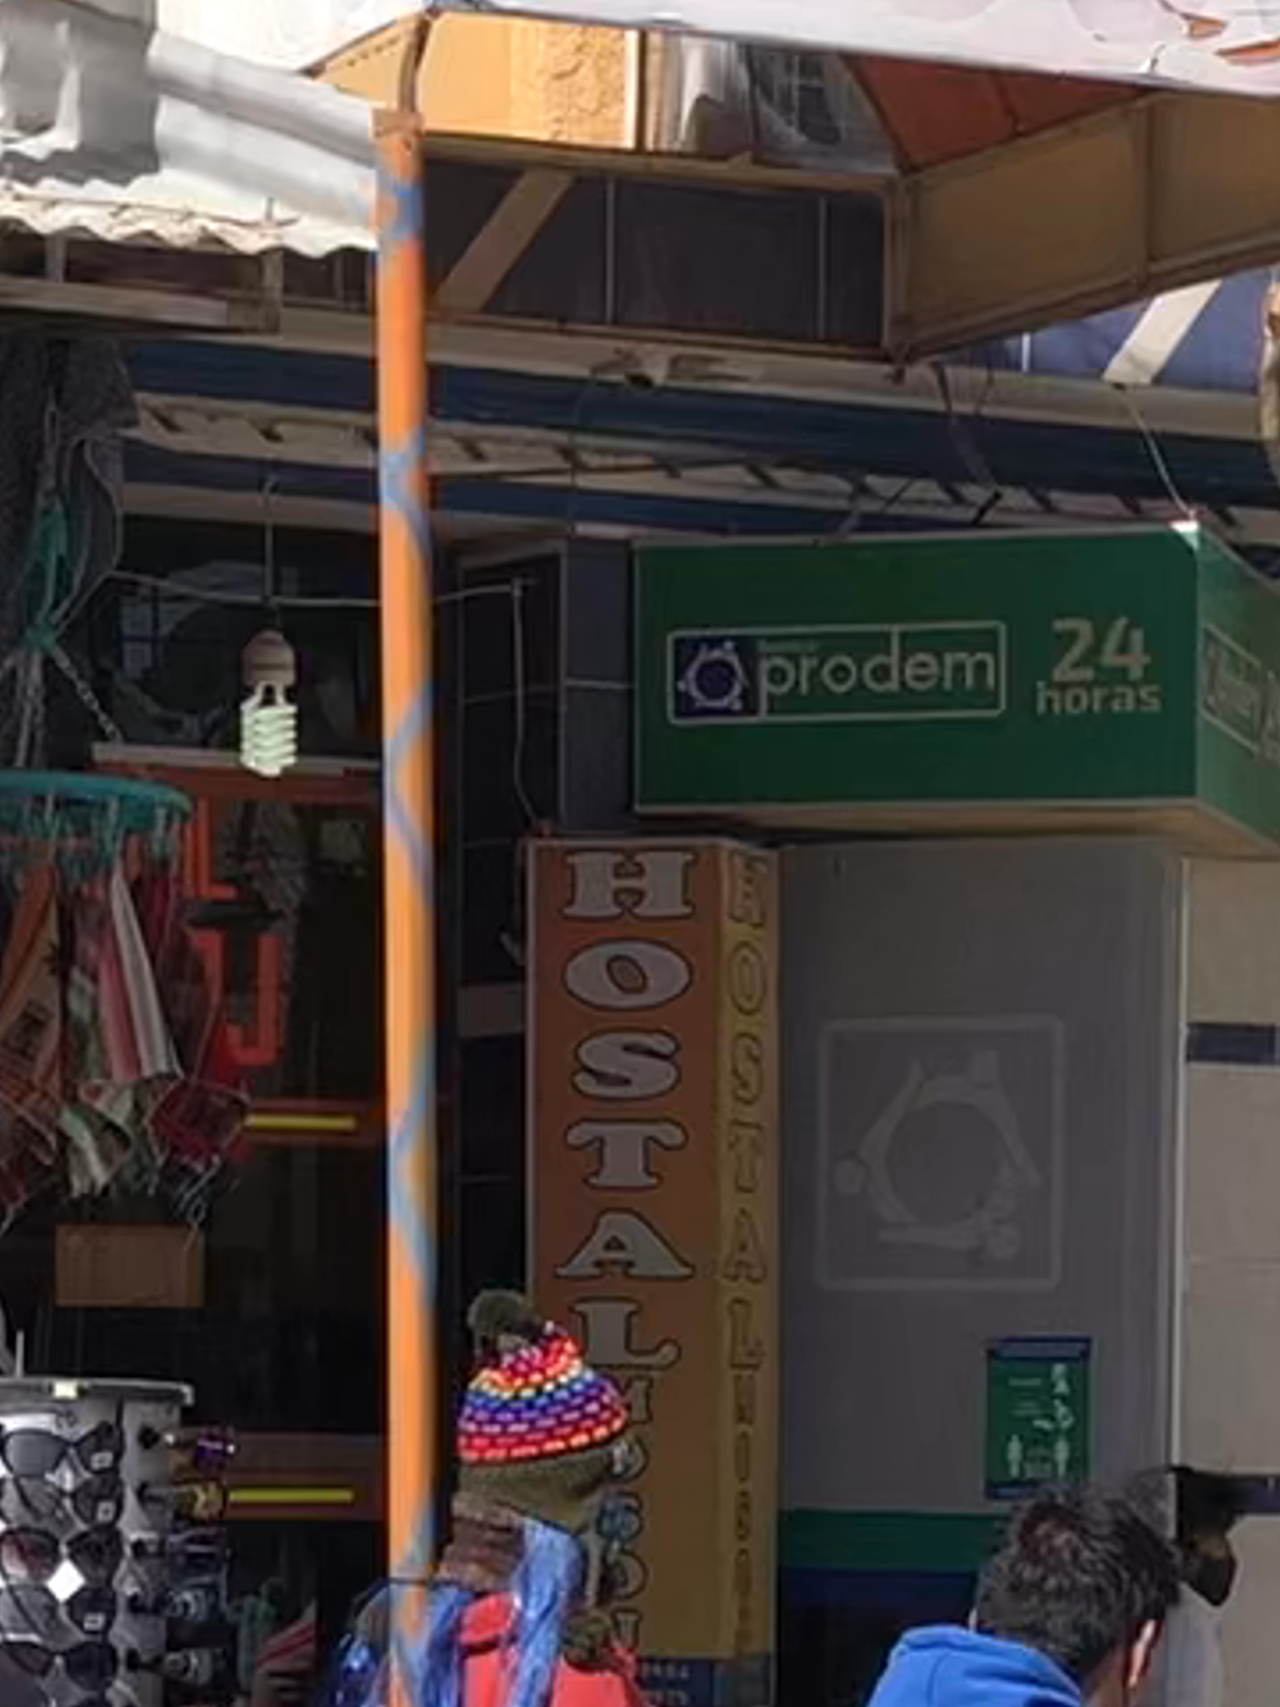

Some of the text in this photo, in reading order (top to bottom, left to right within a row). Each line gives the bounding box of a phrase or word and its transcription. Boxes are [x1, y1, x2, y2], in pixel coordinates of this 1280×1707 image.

[758, 626, 996, 715] prodem
[1051, 616, 1151, 682] 24
[1036, 681, 1162, 716] horas
[554, 848, 696, 1371] HOSTAL
